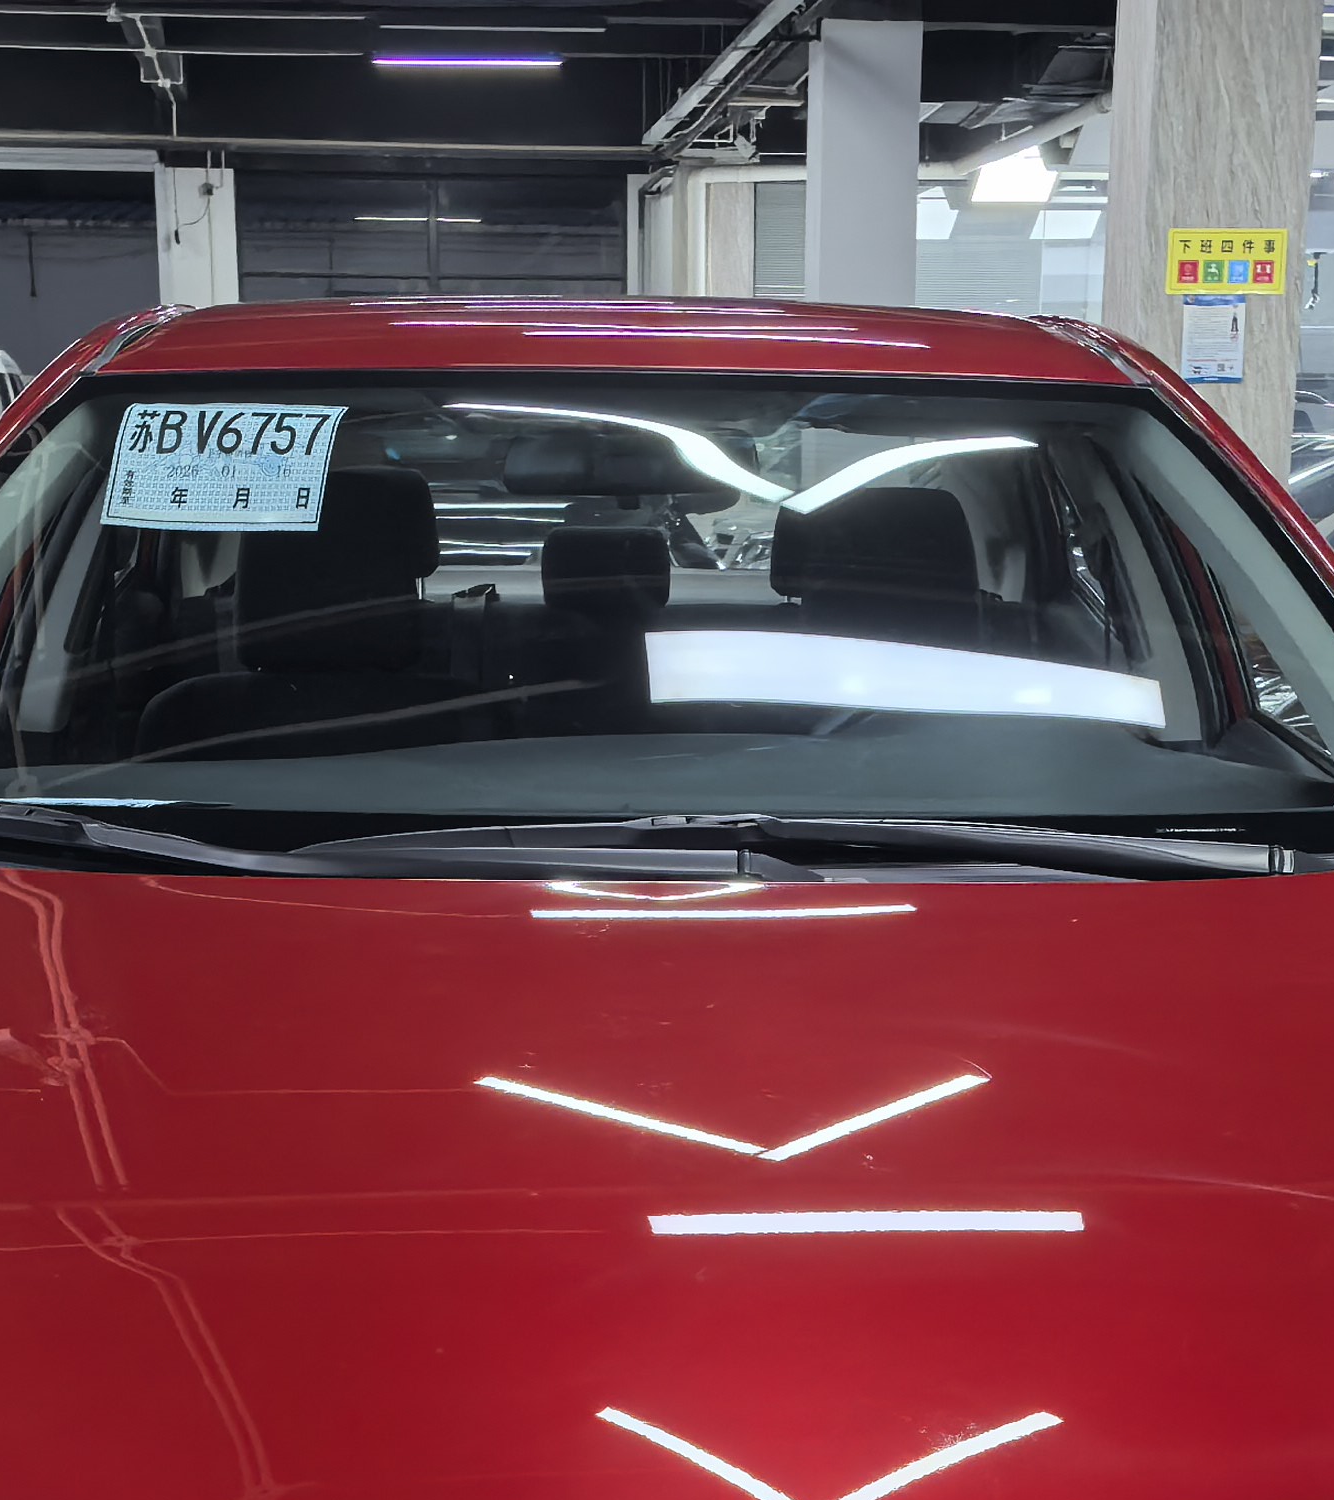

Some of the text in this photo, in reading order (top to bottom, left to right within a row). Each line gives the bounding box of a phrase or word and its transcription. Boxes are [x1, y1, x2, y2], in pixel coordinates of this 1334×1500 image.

[1179, 239, 1276, 254] 下班四件事
[170, 487, 310, 509] 年 月 日
